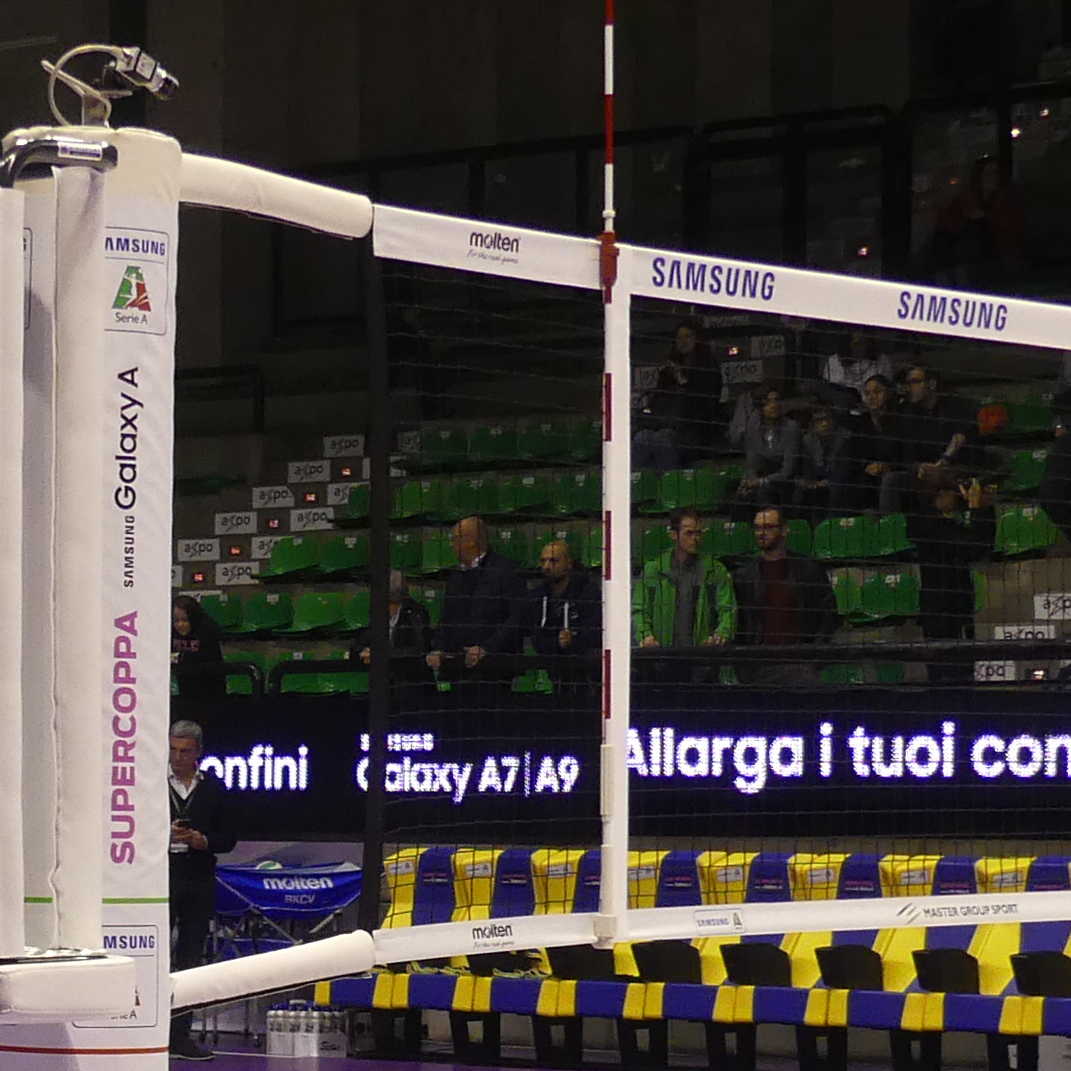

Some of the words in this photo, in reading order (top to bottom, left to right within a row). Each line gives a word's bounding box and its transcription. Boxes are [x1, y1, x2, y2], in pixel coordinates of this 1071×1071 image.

[105, 237, 165, 256] AMSUNG
[470, 232, 518, 253] molten
[652, 257, 775, 300] SAMSUNG
[115, 312, 139, 323] Serie
[141, 314, 148, 324] A
[897, 291, 1008, 331] SAMSUNG
[117, 367, 139, 388] A
[114, 392, 144, 510] Galaxy
[124, 515, 135, 588] SAMSUNG
[110, 610, 138, 865] SUPERCOPPA
[626, 727, 804, 794] Allarga
[820, 722, 832, 777] i
[848, 721, 955, 777] tuoi
[263, 876, 334, 890] molten
[284, 894, 316, 905] BKCV
[923, 907, 960, 918] MASTER
[960, 905, 991, 916] GROUP
[992, 904, 1019, 914] SPORT
[103, 935, 155, 949] MSUNG
[472, 924, 513, 940] molten
